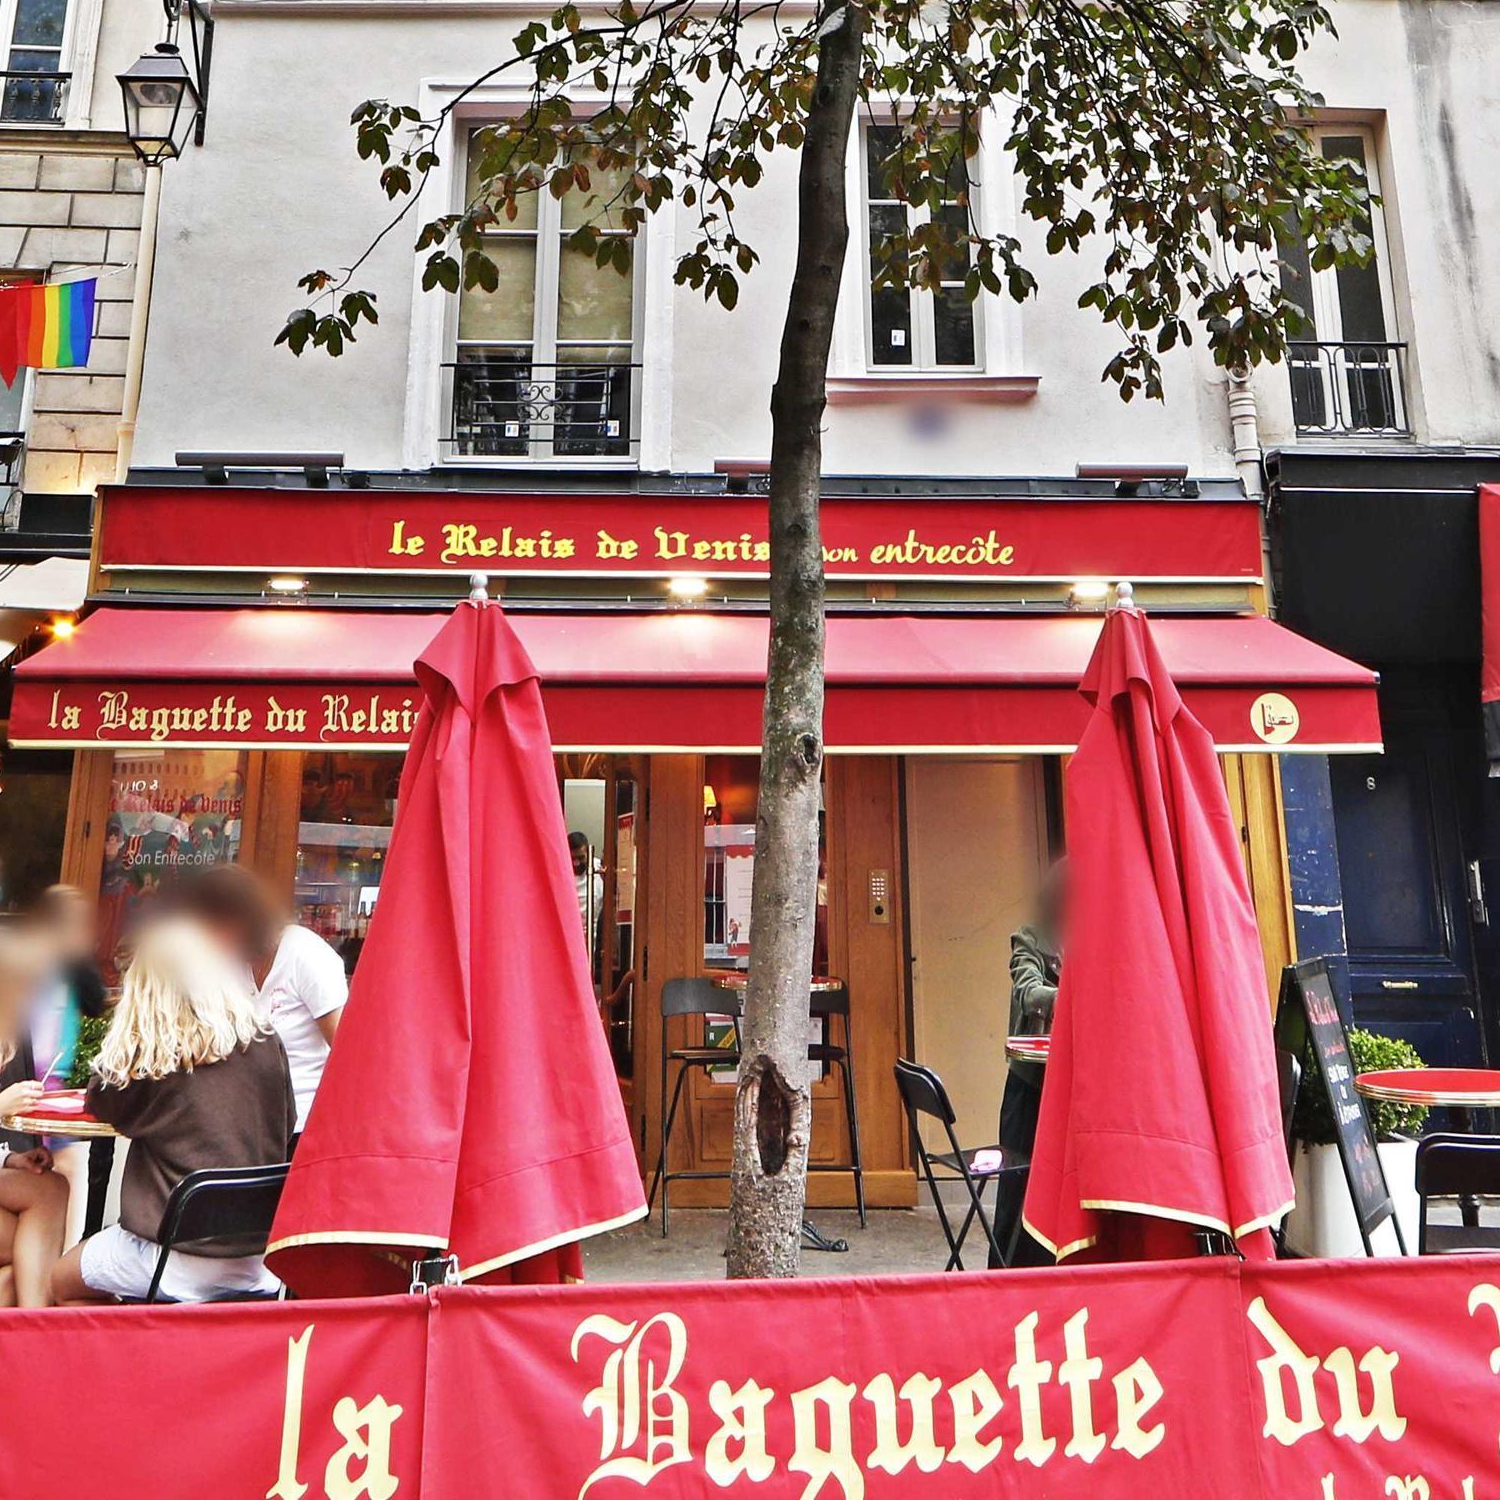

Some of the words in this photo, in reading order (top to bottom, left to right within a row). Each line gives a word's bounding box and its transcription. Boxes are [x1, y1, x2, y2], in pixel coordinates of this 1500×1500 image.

[388, 520, 425, 556] le
[440, 523, 576, 564] Relais
[596, 530, 638, 560] de
[654, 526, 771, 562] Venis
[870, 529, 1014, 565] entrecôte
[47, 689, 82, 729] la
[96, 690, 251, 741] Baguette
[265, 696, 308, 733] du
[1366, 776, 1376, 790] 8
[126, 850, 151, 865] Son
[154, 849, 215, 866] Entrecôte
[265, 1324, 404, 1500] la
[570, 1306, 1166, 1500] Baguette
[1246, 1295, 1409, 1447] du
